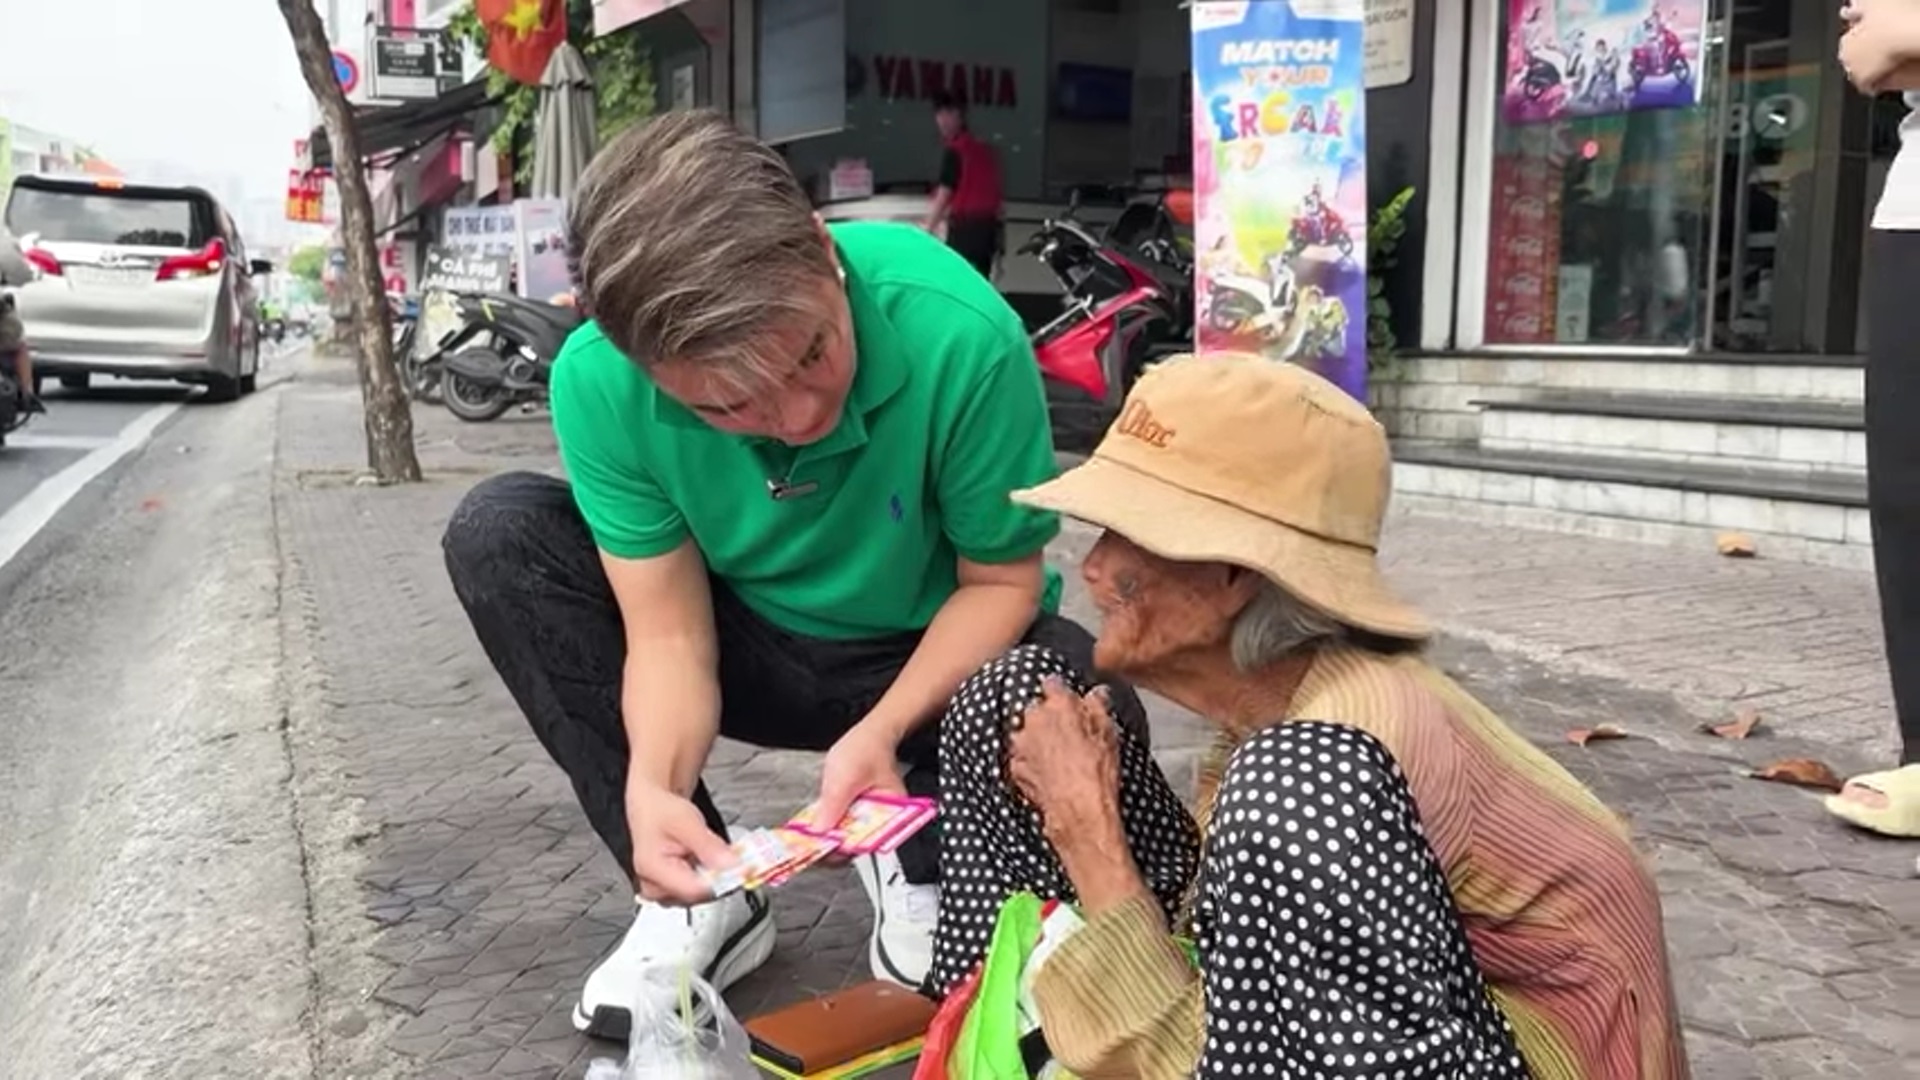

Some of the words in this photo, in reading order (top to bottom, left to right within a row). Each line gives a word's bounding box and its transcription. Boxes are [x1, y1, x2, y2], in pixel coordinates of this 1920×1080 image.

[1221, 38, 1340, 66] MATCH
[874, 54, 1017, 107] YAMAHA
[1241, 66, 1331, 86] YOUR
